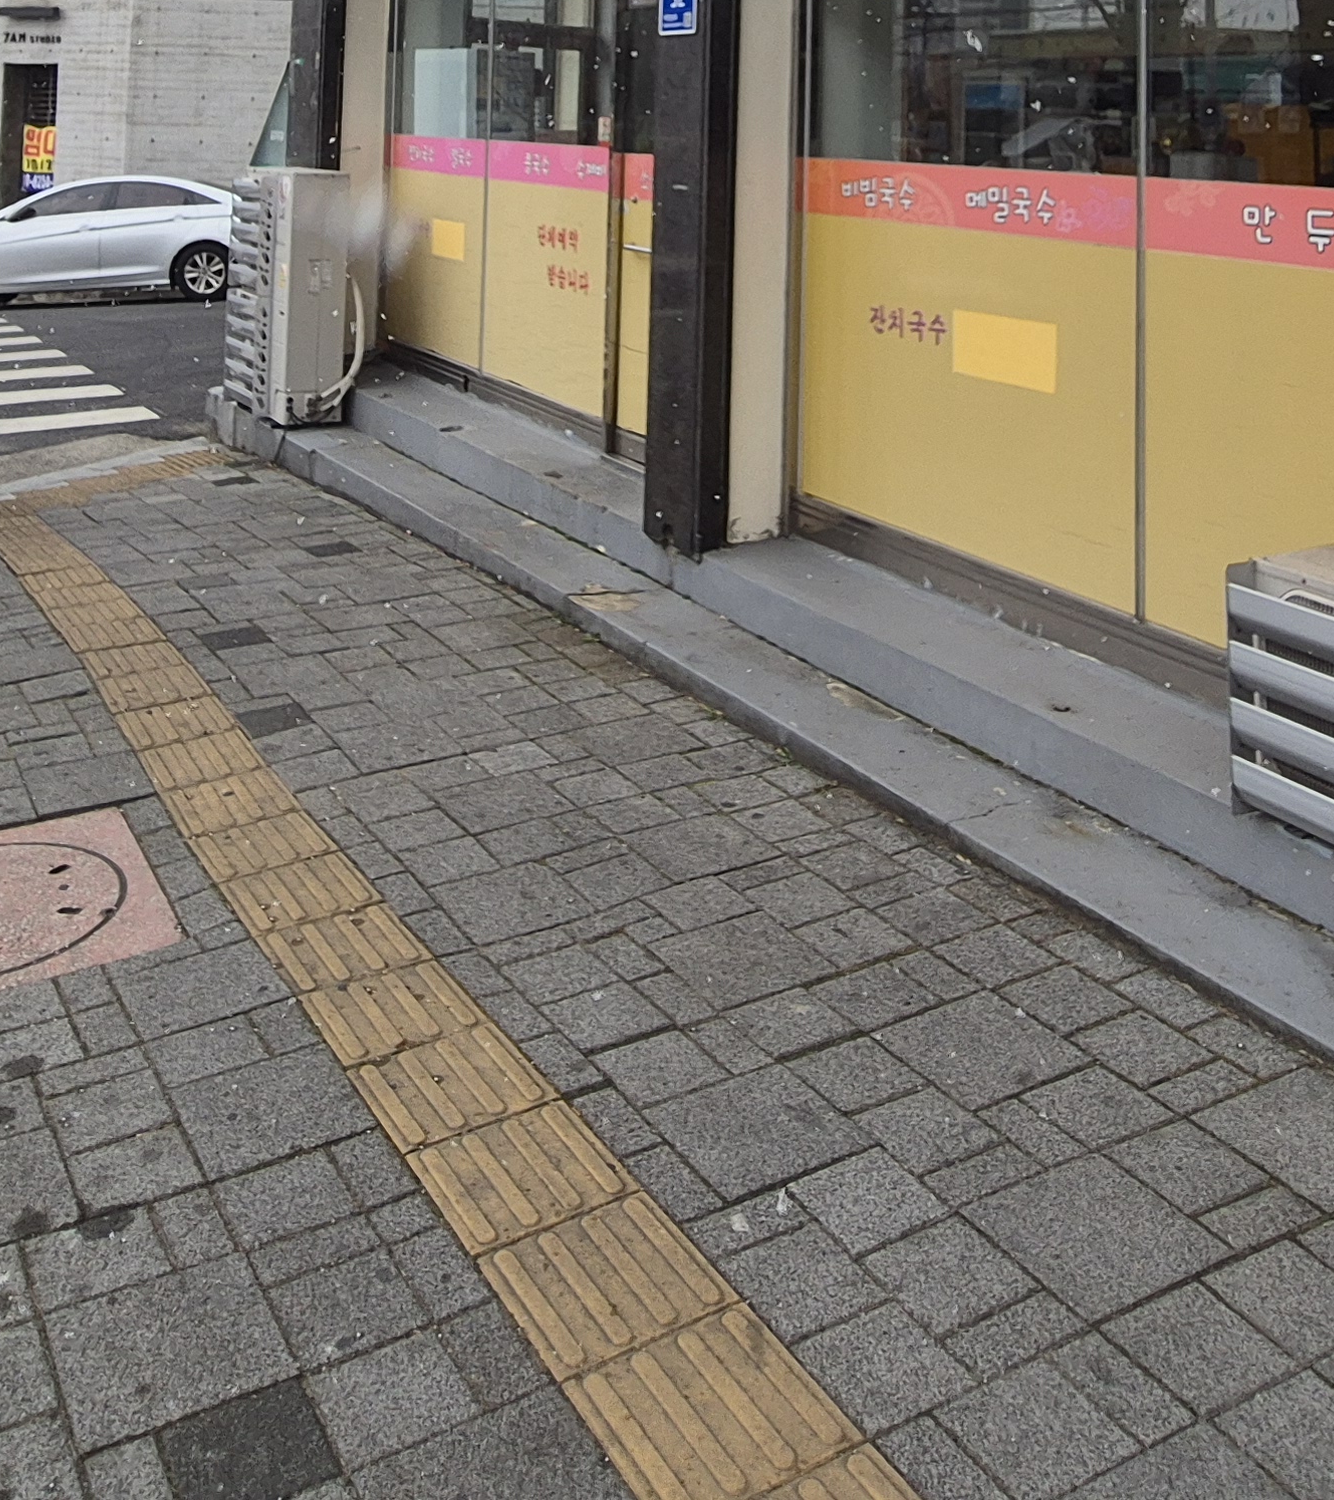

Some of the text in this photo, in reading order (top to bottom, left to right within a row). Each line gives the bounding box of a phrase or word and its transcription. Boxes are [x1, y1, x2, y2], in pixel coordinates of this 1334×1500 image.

[840, 176, 916, 211] 비빔국수
[963, 185, 1056, 226] 메밀국수
[869, 304, 948, 345] 잔치국수
